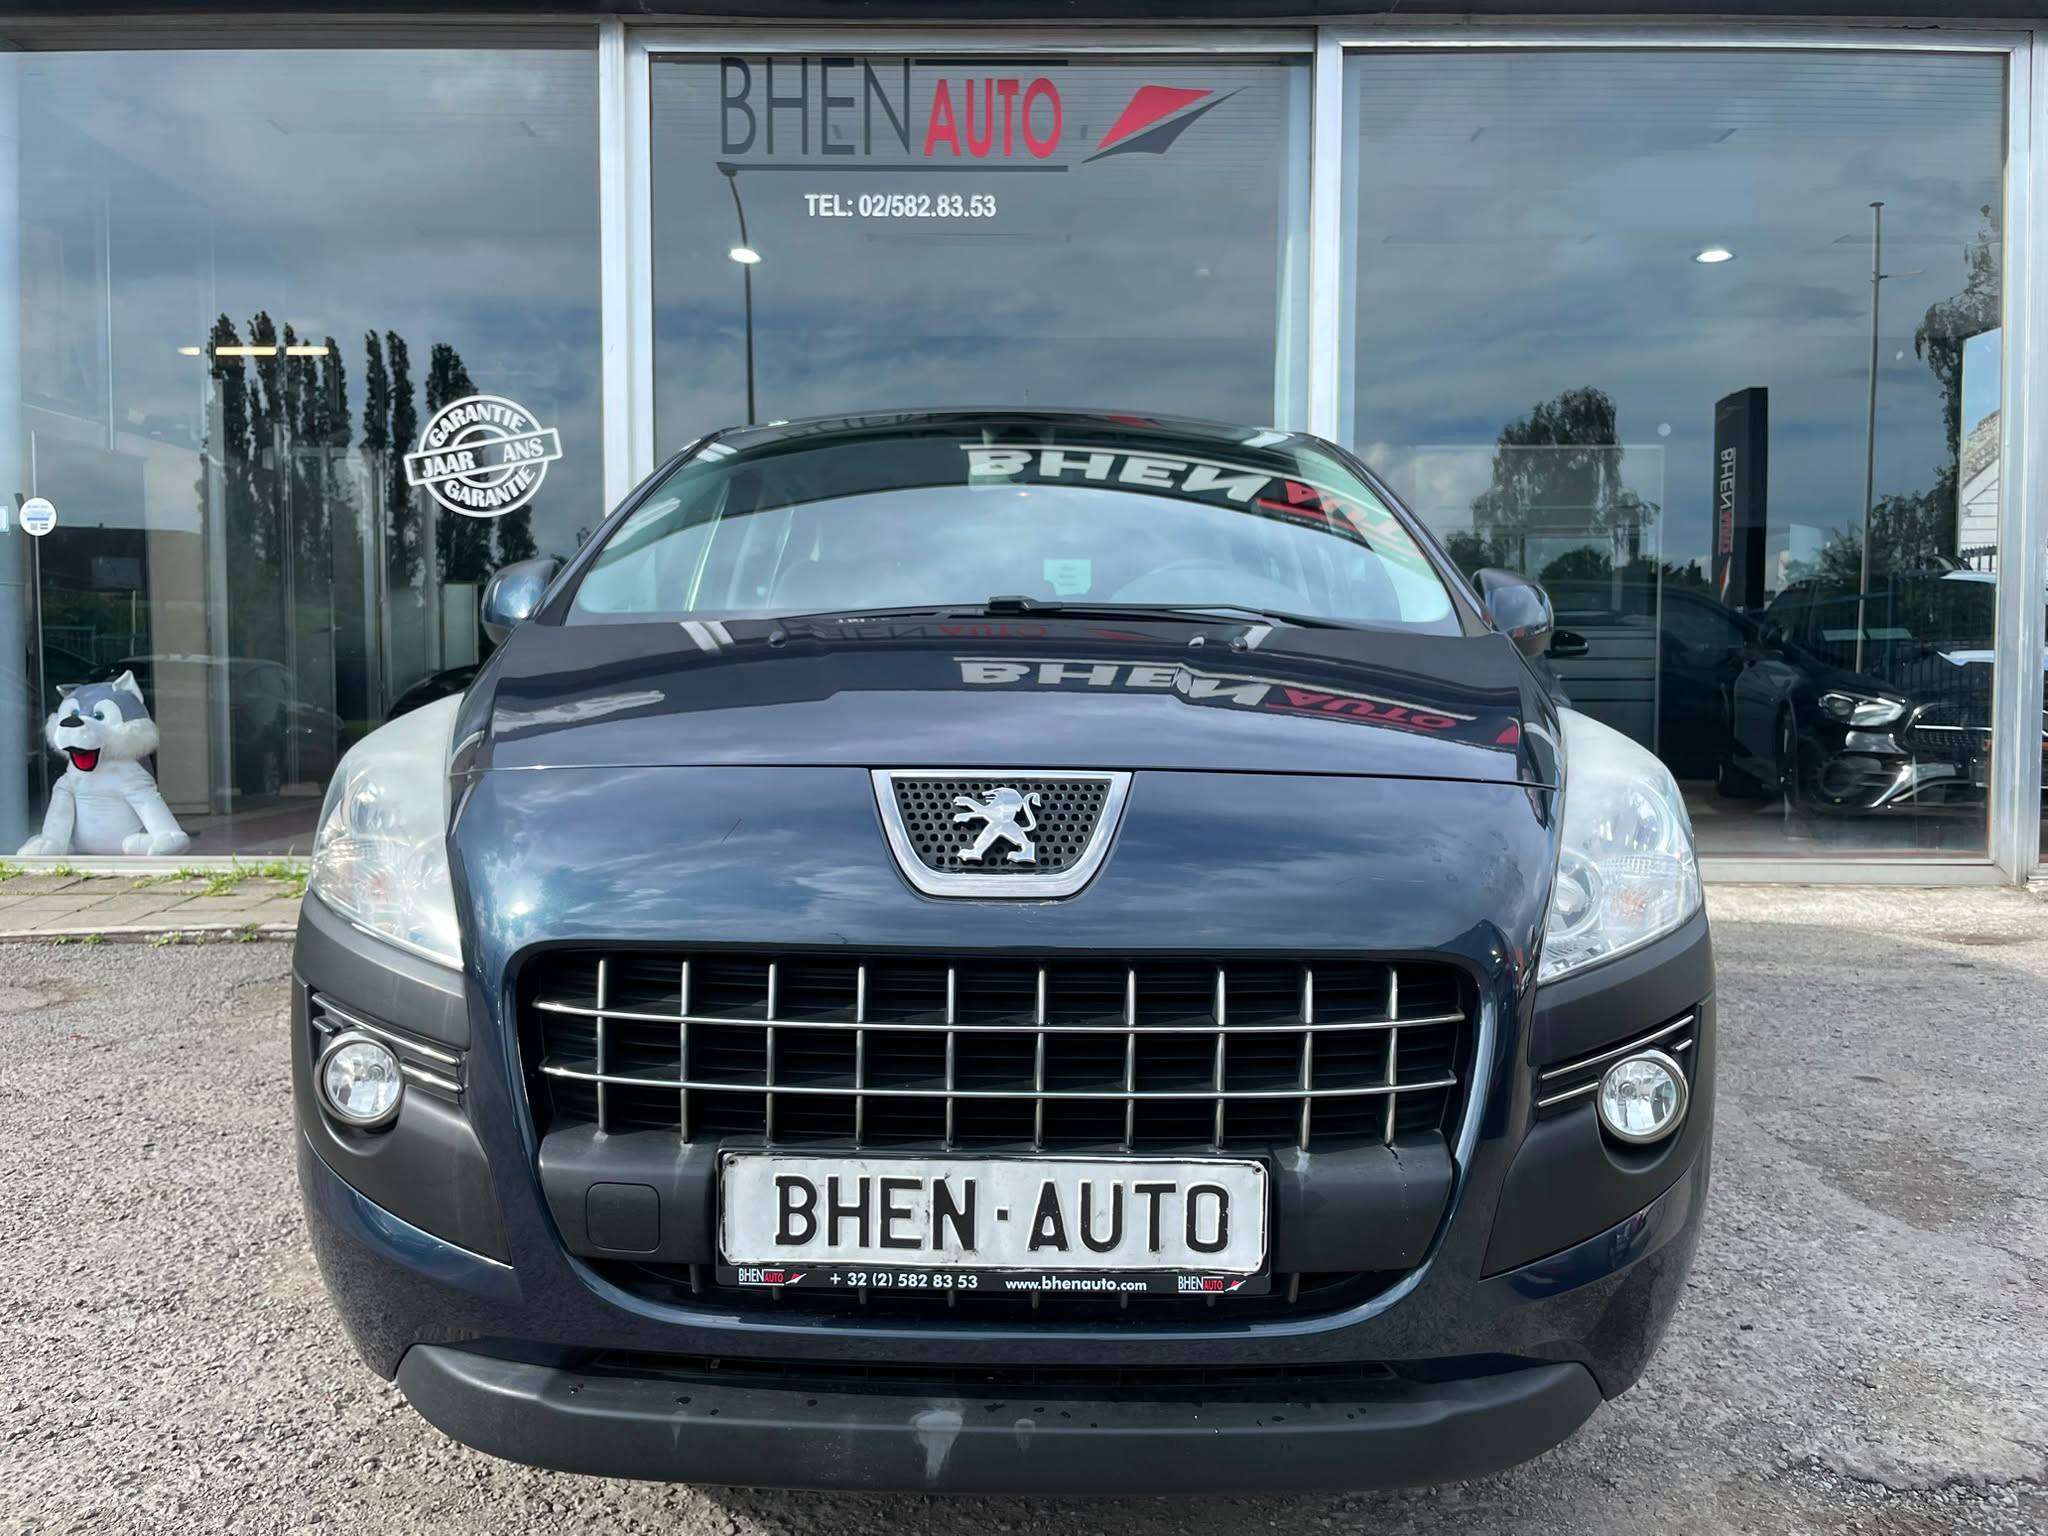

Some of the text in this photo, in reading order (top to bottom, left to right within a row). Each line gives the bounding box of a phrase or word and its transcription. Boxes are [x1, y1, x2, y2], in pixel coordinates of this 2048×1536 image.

[805, 194, 997, 218] TEL: 02/582.83.53
[429, 403, 527, 447] GARANTIE
[422, 437, 545, 478] JAAR ANS
[444, 464, 536, 507] GARANTIE
[847, 1272, 867, 1286] 32
[872, 1273, 893, 1287] (2)
[898, 1274, 928, 1287] 582
[933, 1274, 953, 1288] 83
[957, 1275, 978, 1289] 53
[1005, 1275, 1147, 1291] www.bhenauto.com
